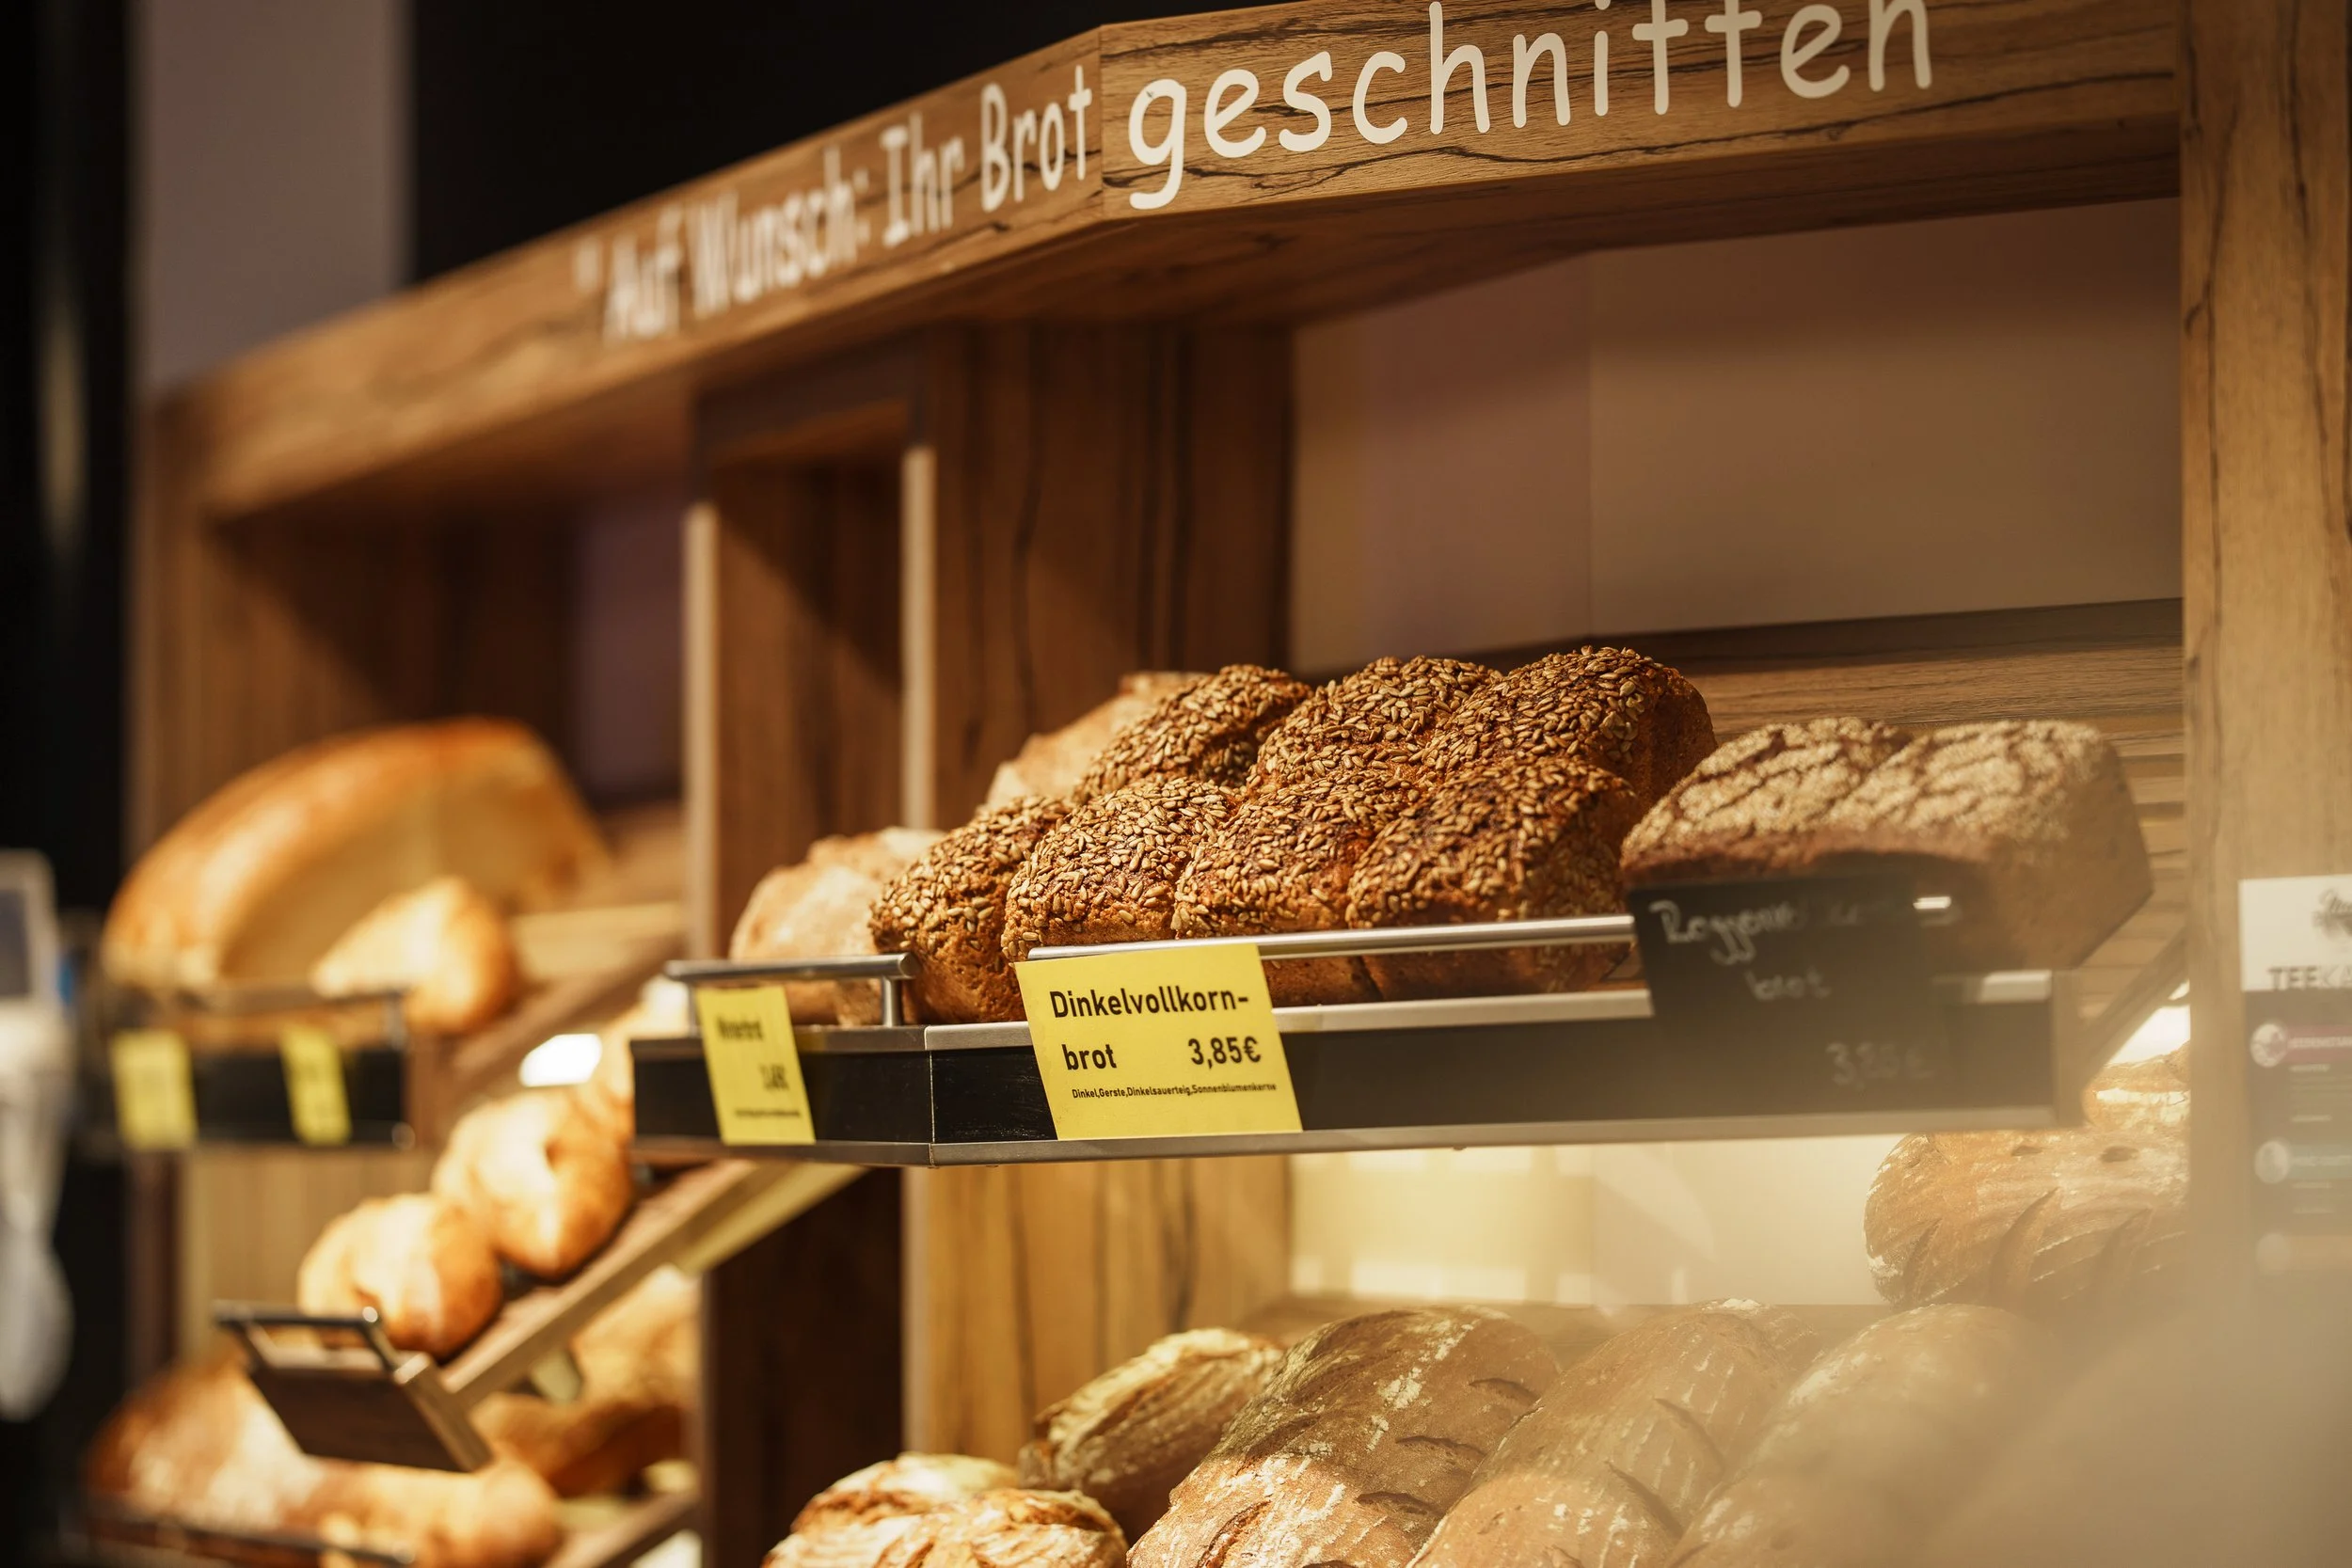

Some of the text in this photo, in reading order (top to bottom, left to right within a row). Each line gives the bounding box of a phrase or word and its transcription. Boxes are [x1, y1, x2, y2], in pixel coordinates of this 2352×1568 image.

[686, 143, 870, 320] Wunsch:
[880, 110, 965, 247] Ihr
[979, 64, 1092, 212] Brot
[1128, 0, 1933, 210] geschnitten
[1050, 986, 1248, 1018] Dinkelvollkorn-
[1062, 1036, 1262, 1070] brot 3,85€
